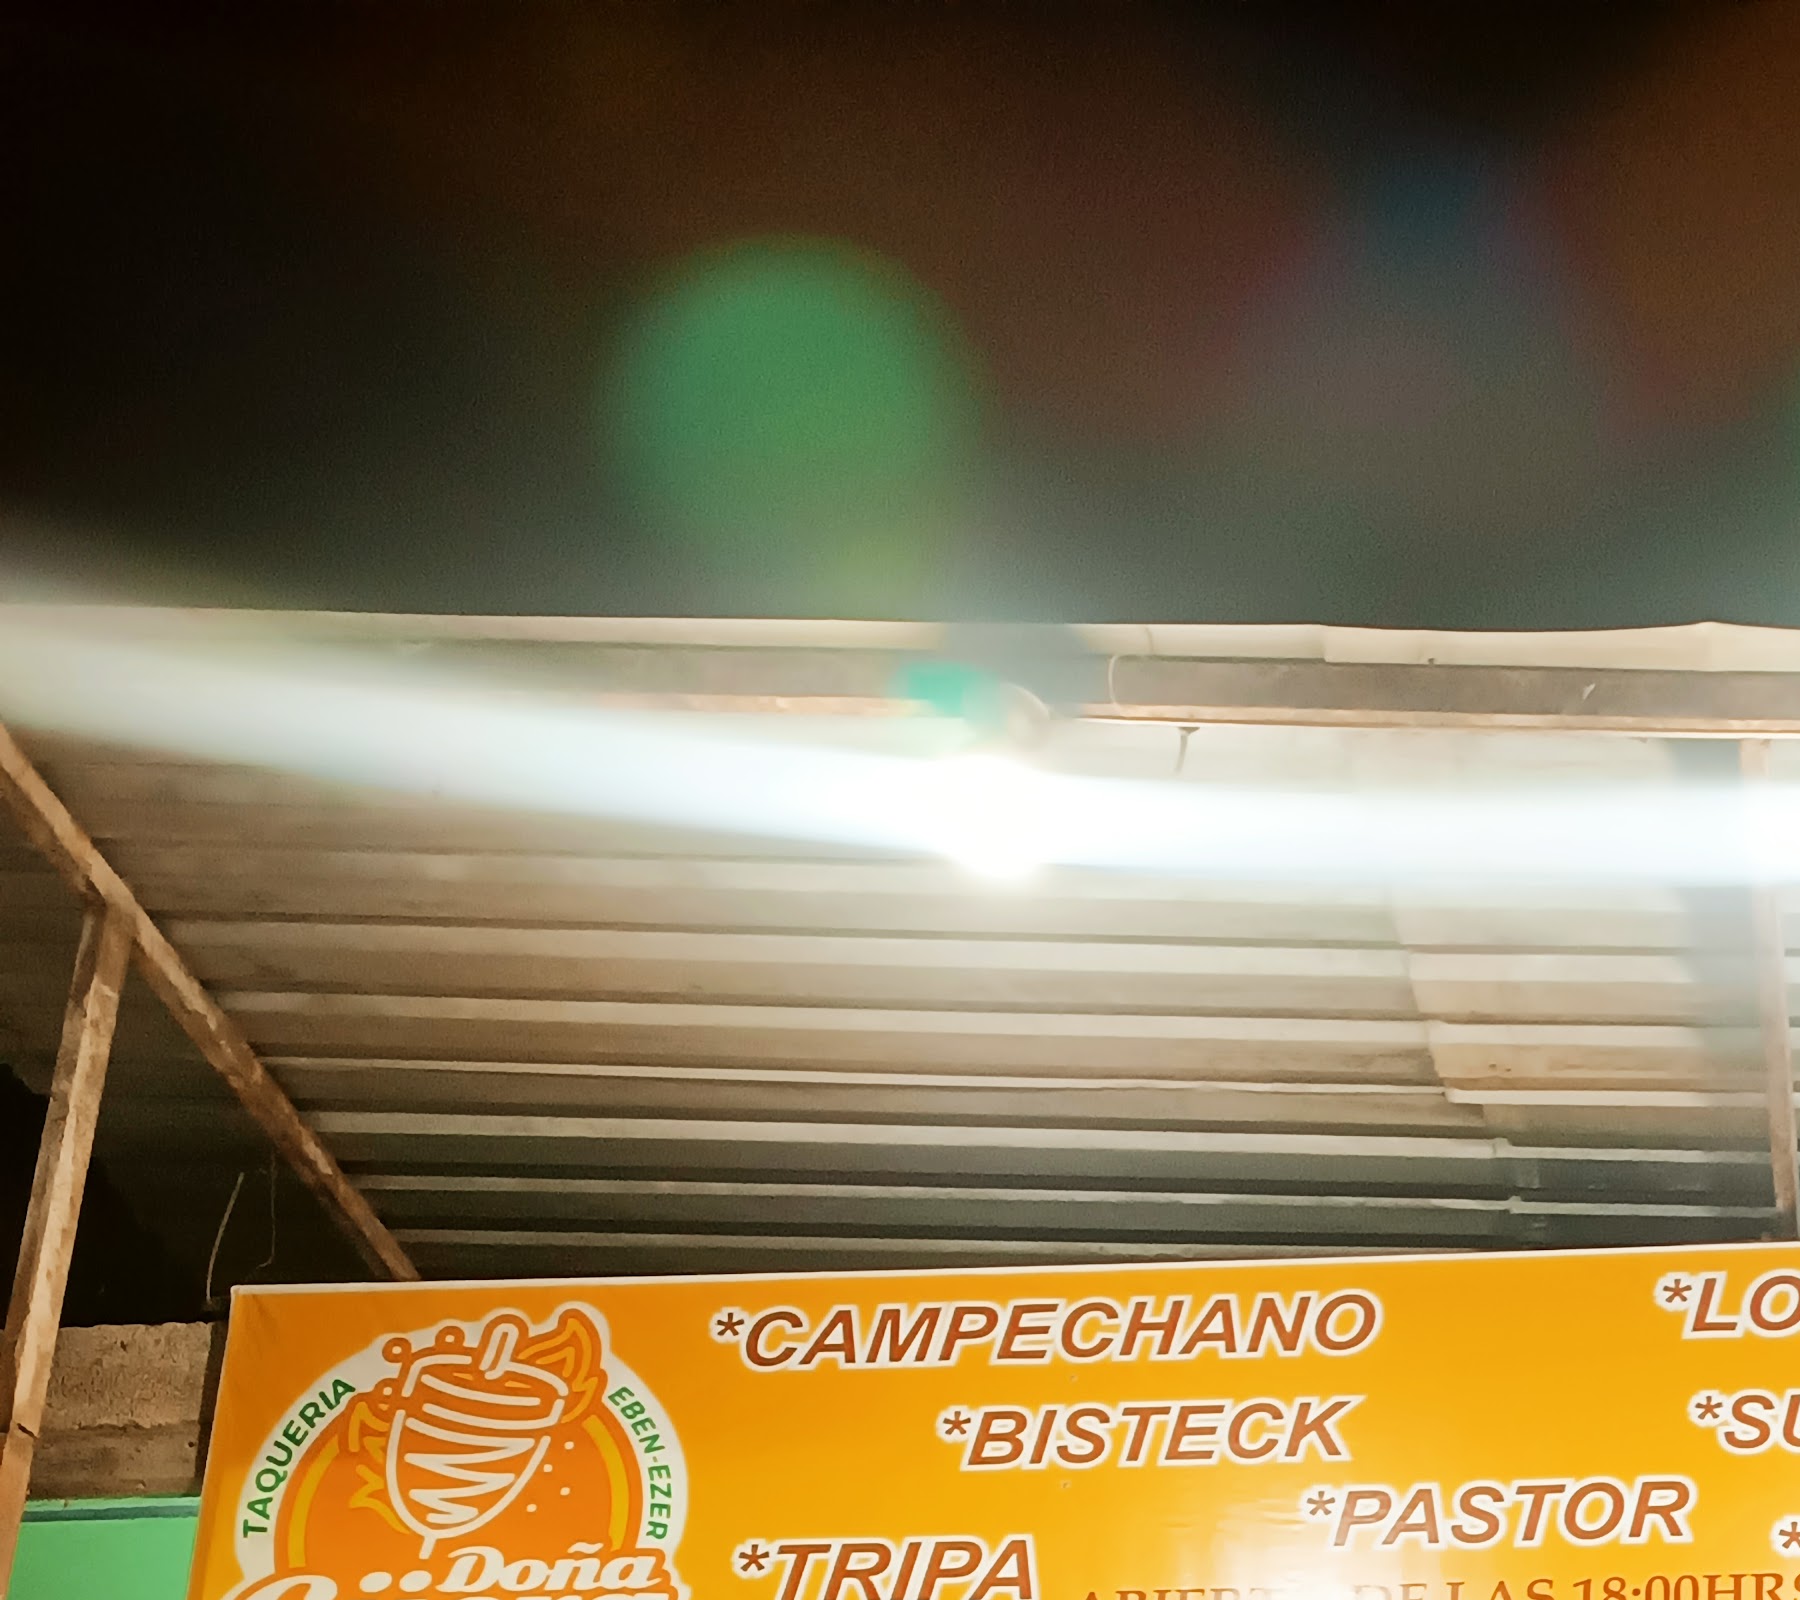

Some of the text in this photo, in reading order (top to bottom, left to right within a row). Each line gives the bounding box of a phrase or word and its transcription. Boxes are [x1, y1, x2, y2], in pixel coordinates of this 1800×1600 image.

[243, 1377, 673, 1541] TAQUERIA EBEN-EZER
[437, 1541, 662, 1593] Doña
